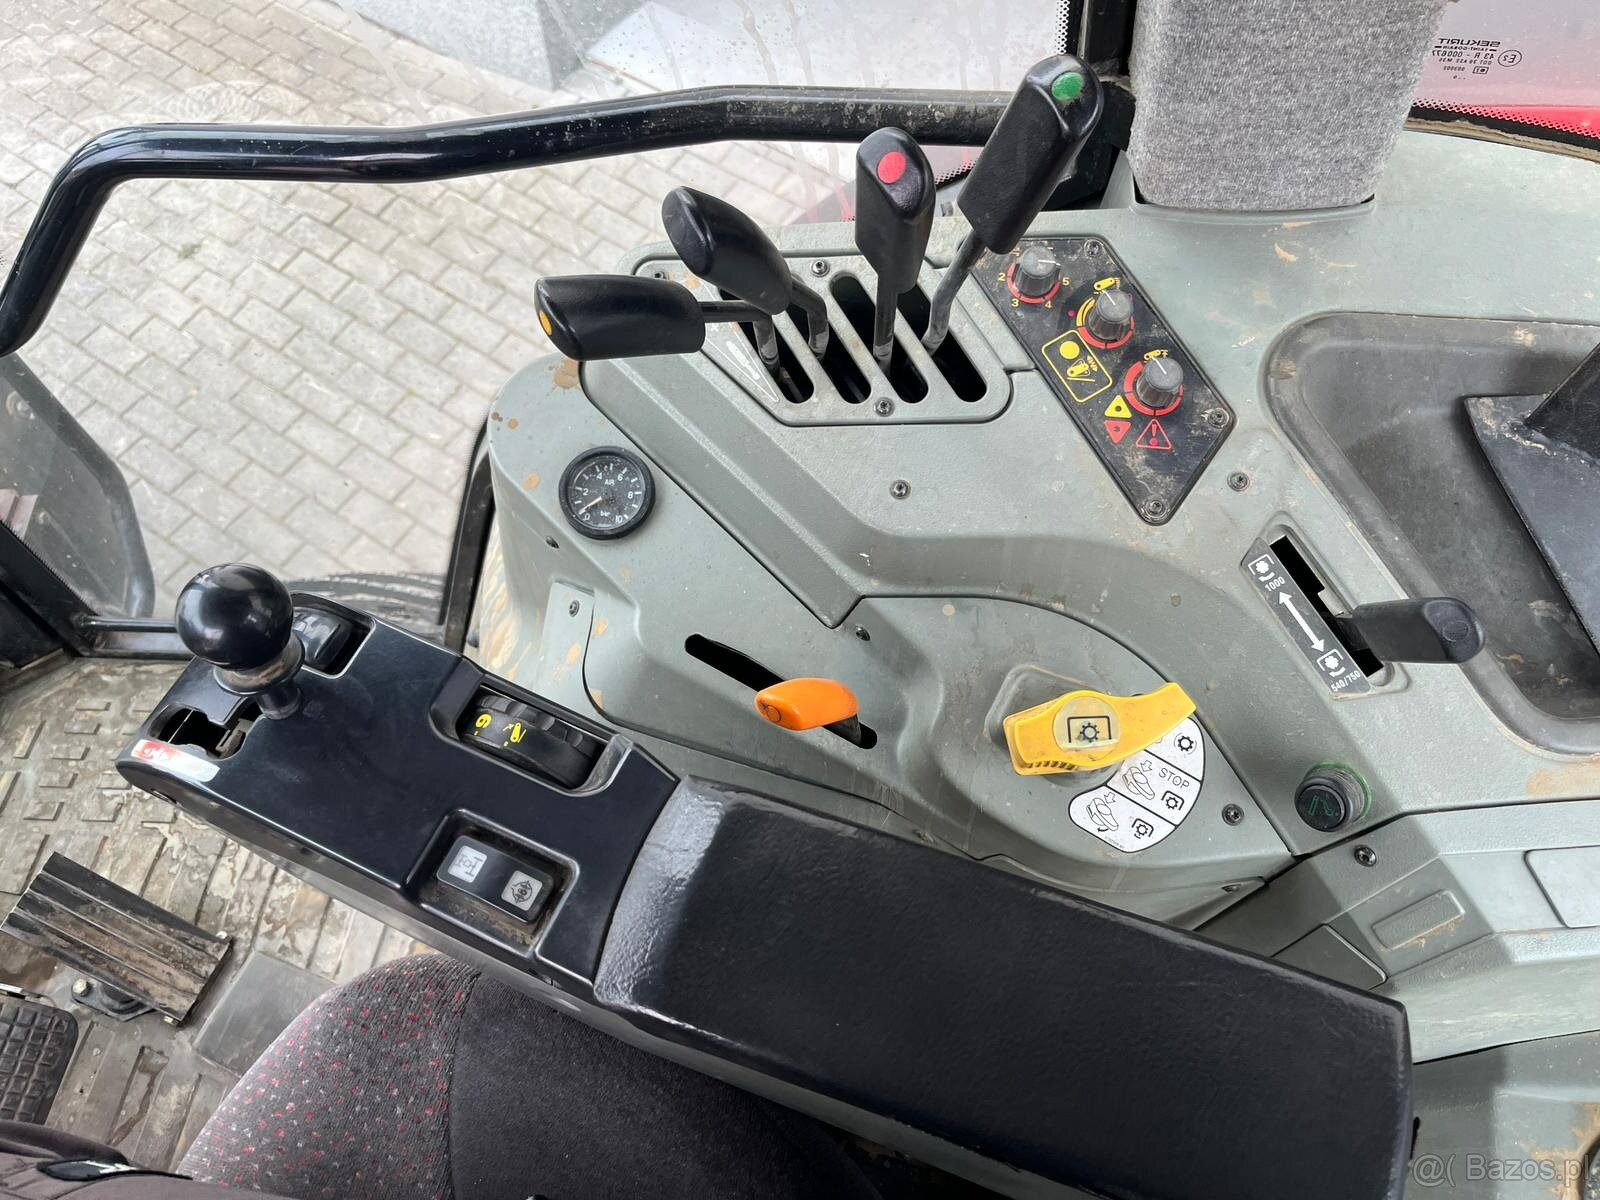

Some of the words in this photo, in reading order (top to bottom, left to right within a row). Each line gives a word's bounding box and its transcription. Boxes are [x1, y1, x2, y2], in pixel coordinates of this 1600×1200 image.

[998, 272, 1006, 281] 2
[1062, 277, 1070, 286] 5
[1011, 298, 1020, 307] 3
[1264, 576, 1285, 592] 1000
[1330, 670, 1361, 692] 540/750
[1158, 767, 1190, 790] STOP
